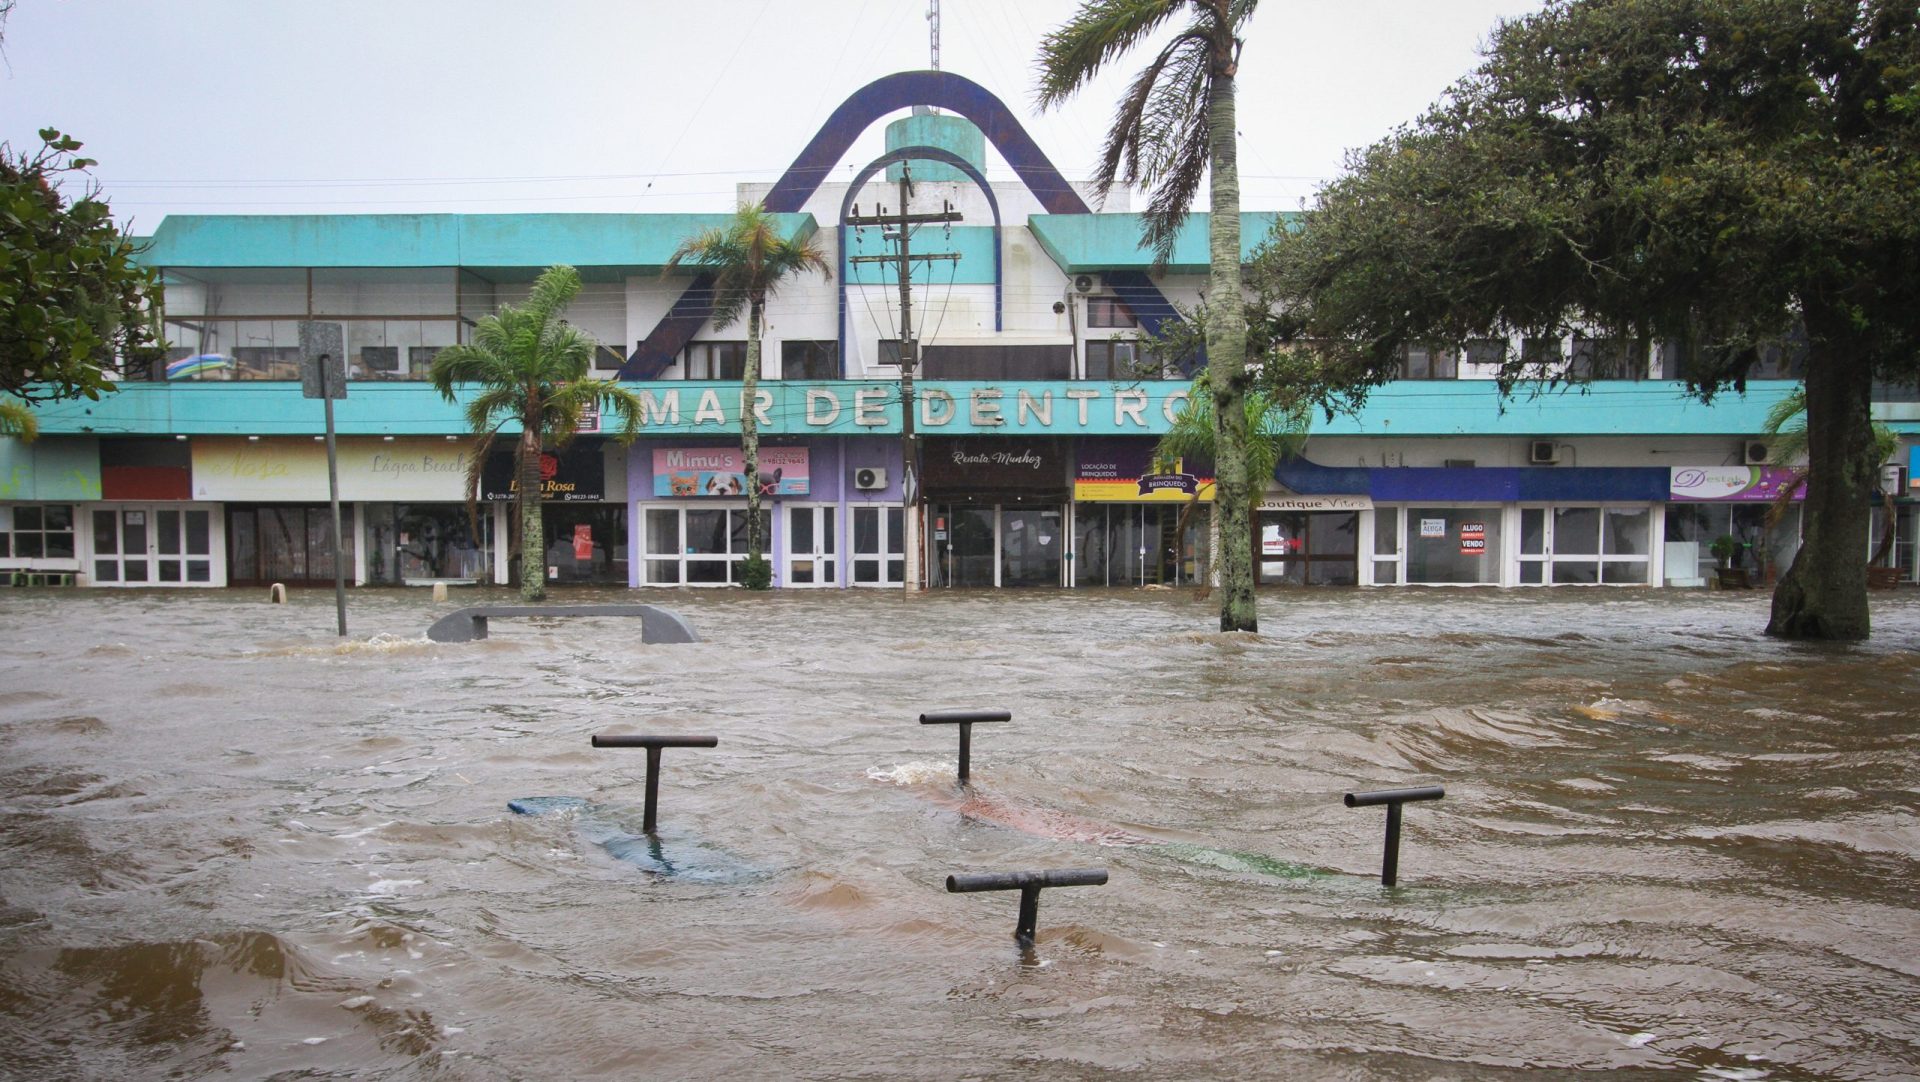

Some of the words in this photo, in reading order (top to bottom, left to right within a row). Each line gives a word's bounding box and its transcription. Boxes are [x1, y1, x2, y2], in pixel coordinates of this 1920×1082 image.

[640, 389, 773, 426] MAR
[806, 389, 889, 426] DE
[921, 389, 1190, 426] DENTRO
[422, 452, 467, 473] Beach
[667, 450, 734, 467] Mimu's
[952, 453, 990, 465] Renata
[992, 449, 1041, 469] Munhoz
[546, 480, 575, 491] Rosa
[1149, 480, 1188, 488] BRINQUEDO
[1259, 500, 1322, 509] Boutique
[1462, 524, 1483, 532] ALUGO
[1462, 540, 1484, 548] VENDO
